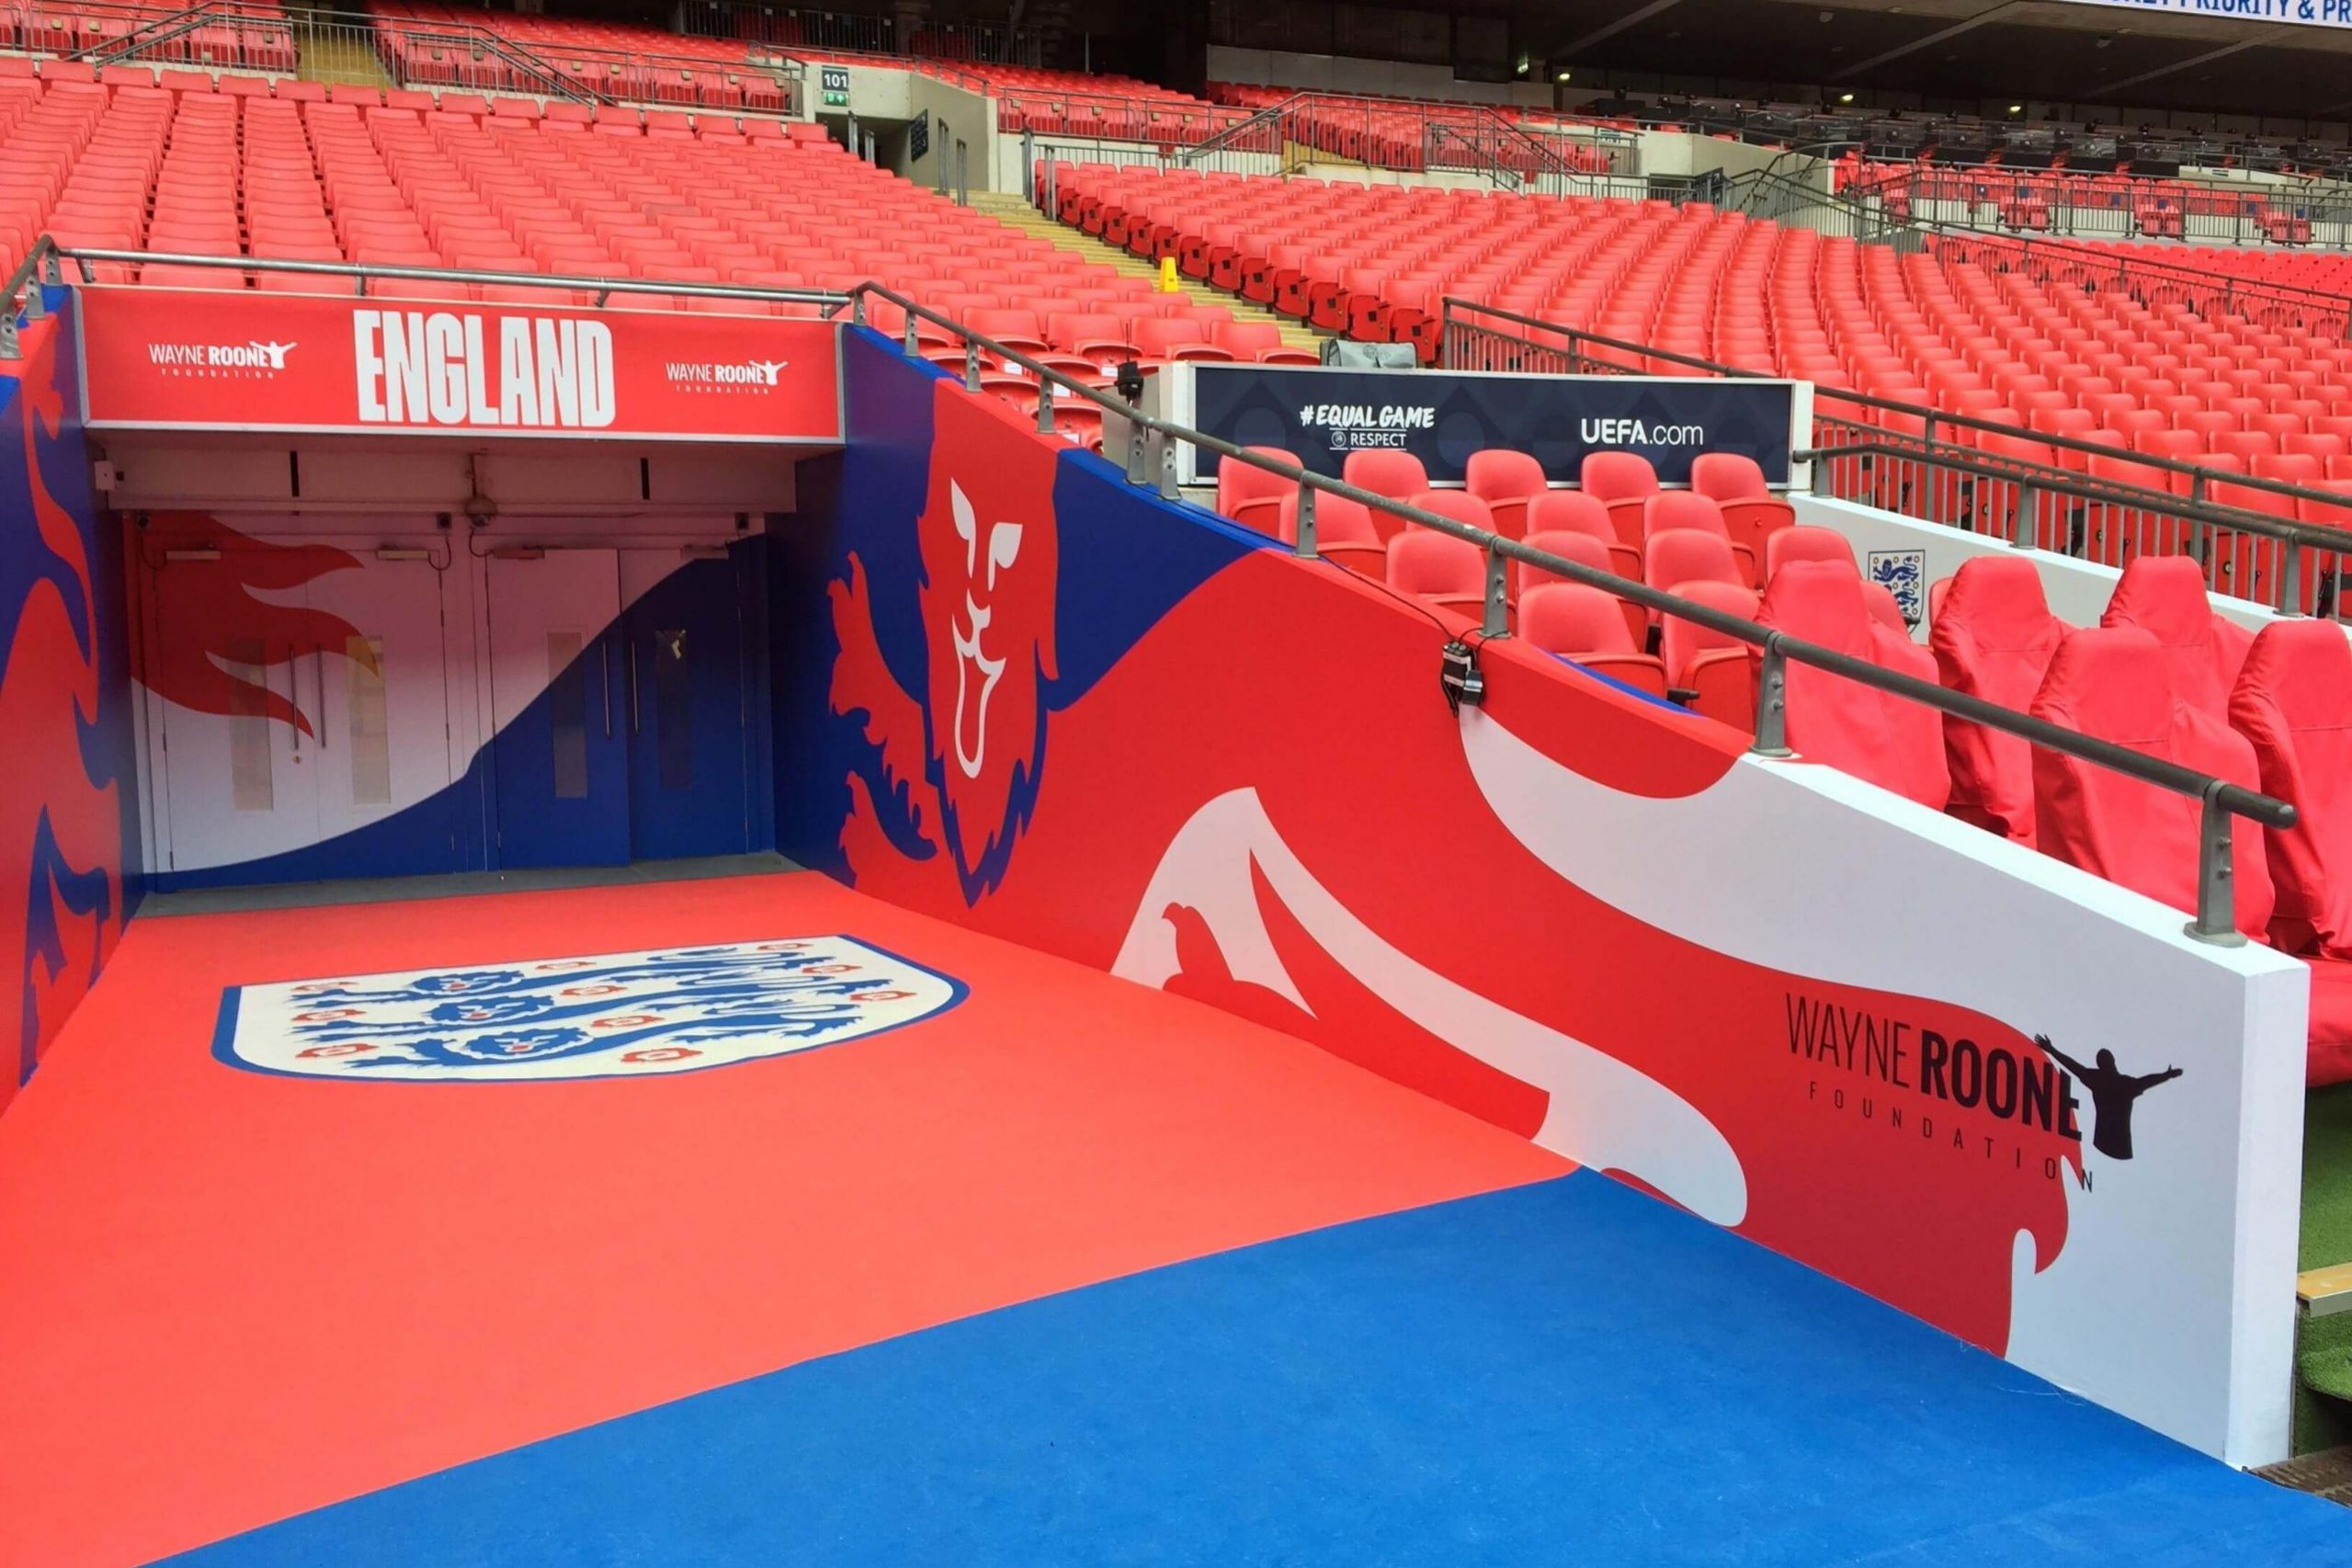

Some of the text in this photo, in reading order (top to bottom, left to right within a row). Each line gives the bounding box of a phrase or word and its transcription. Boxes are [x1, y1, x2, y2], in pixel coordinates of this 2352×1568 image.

[2179, 0, 2290, 17] ORITY
[824, 74, 847, 88] 101
[148, 343, 207, 366] WAYNE
[353, 309, 616, 427] ENGLAND
[665, 361, 713, 382] WAYNE
[1350, 433, 1407, 447] RESPECT
[1581, 418, 1704, 445] UEFA.com
[1785, 992, 1911, 1088] WAYNE
[1810, 1080, 2093, 1193] FOUNDATION
